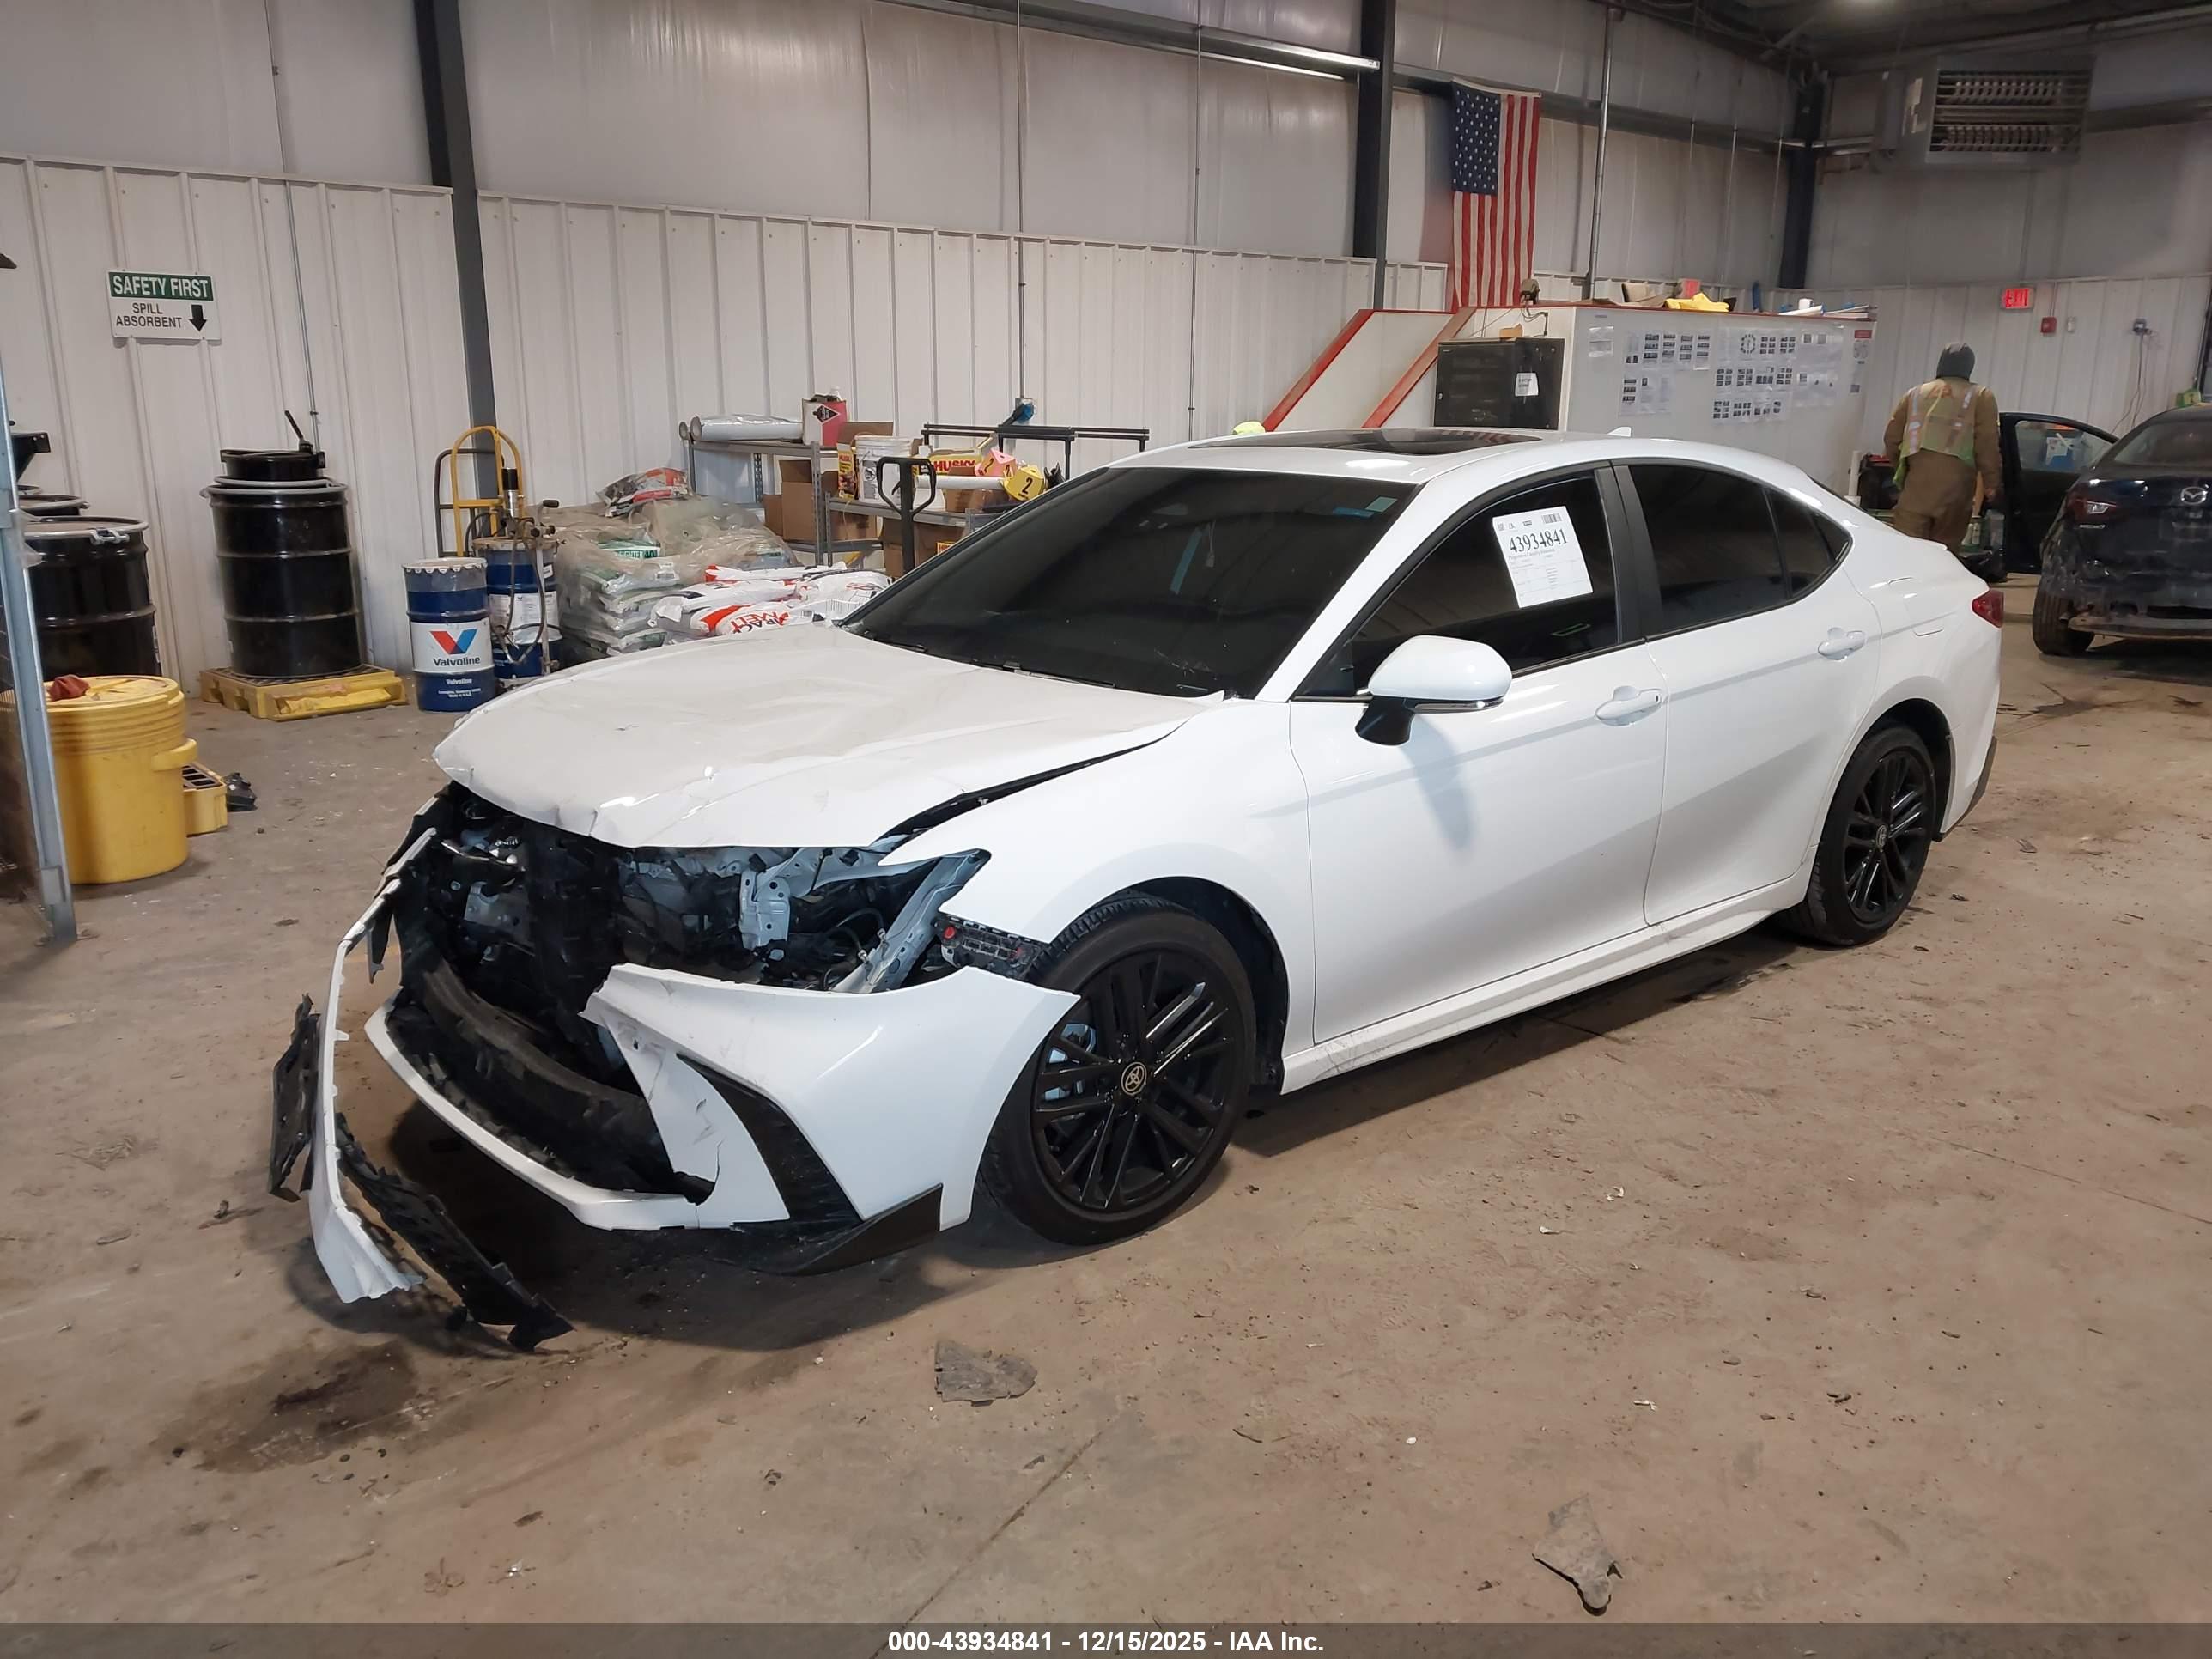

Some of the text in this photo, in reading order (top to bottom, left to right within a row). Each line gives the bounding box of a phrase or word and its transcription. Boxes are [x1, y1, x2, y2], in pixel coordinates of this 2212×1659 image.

[112, 275, 209, 298] SAFETY FIRST
[132, 302, 164, 315] SPILL
[116, 315, 182, 328] ABSORBENT
[1021, 477, 1033, 495] 2
[1509, 528, 1567, 553] 43934841
[432, 656, 481, 666] Valvoline
